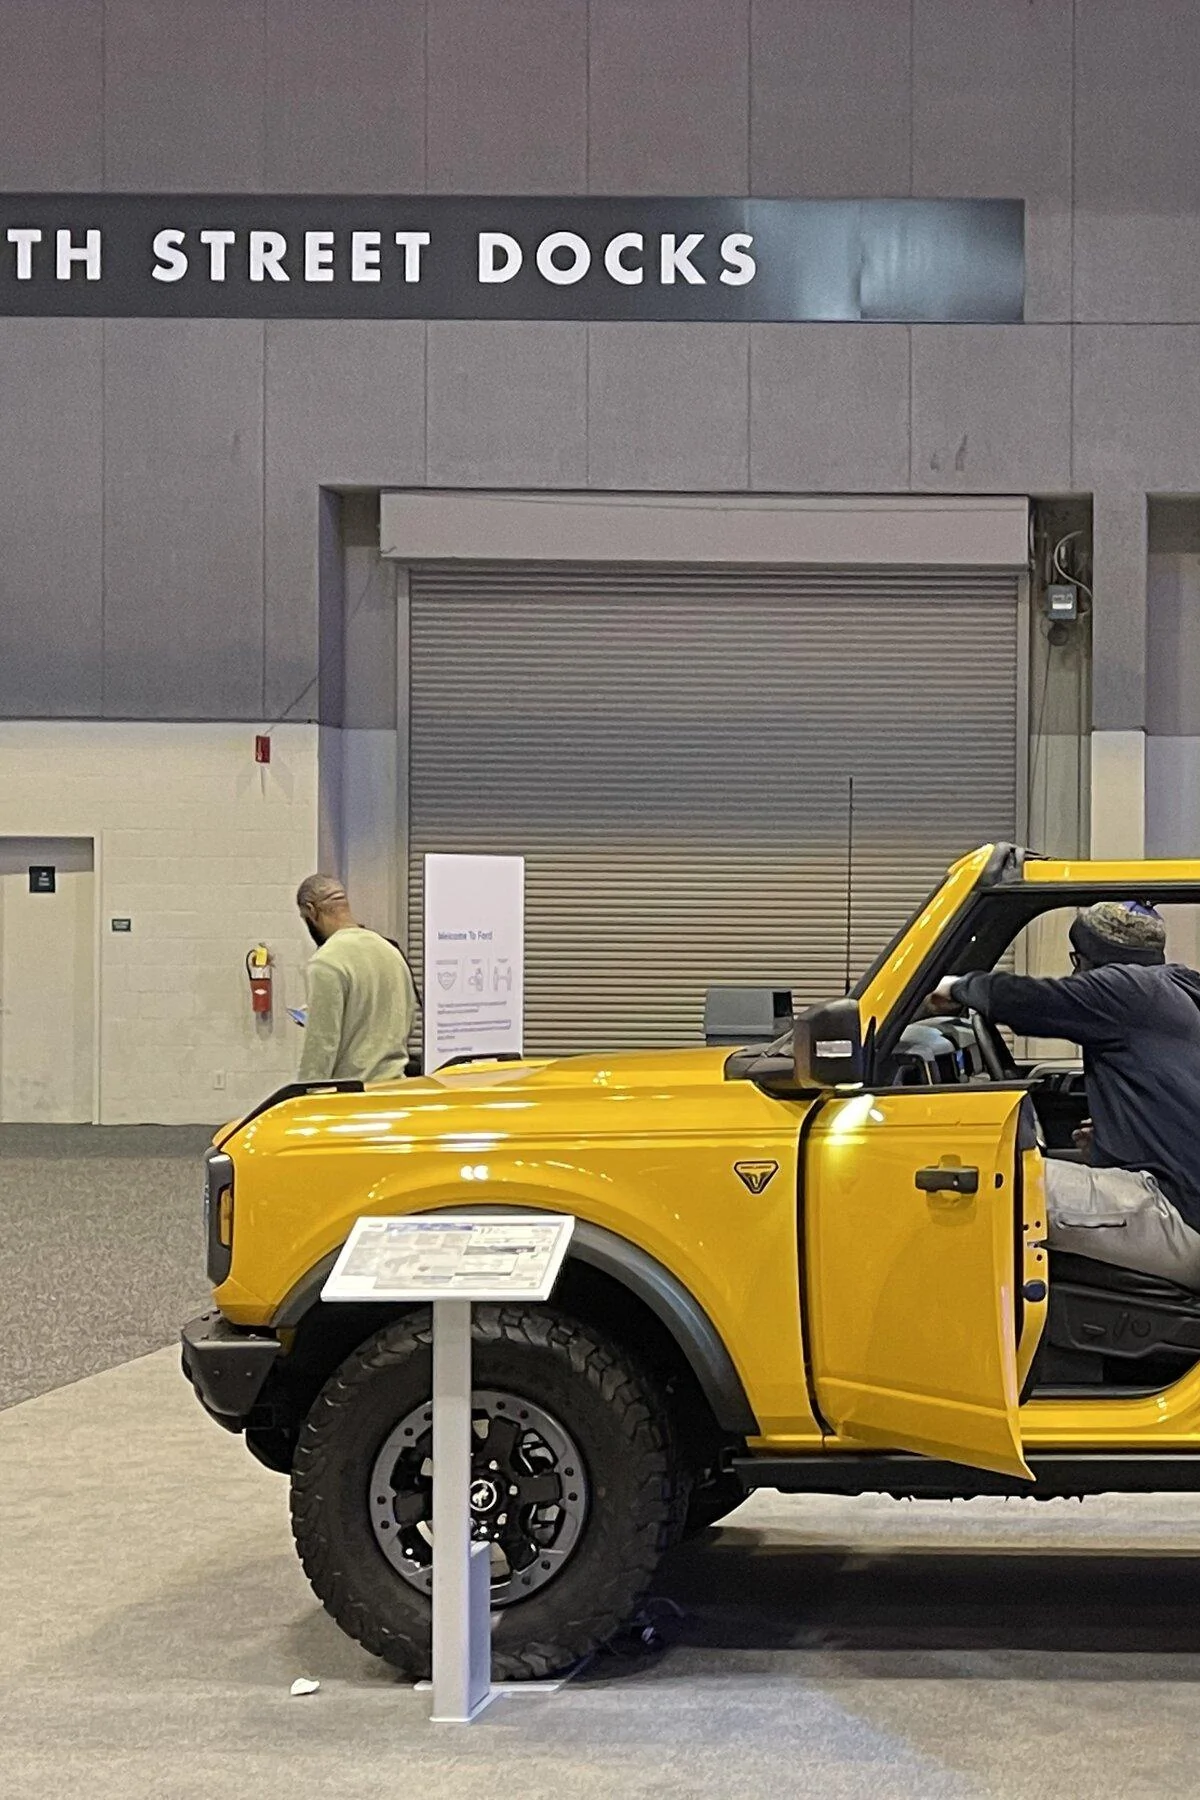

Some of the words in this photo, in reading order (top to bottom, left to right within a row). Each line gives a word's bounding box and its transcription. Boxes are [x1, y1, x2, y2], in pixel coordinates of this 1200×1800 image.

[6, 228, 102, 281] TH
[150, 229, 432, 283] STREET
[476, 231, 757, 286] DOCKS
[468, 930, 477, 941] To
[478, 930, 493, 941] Ford
